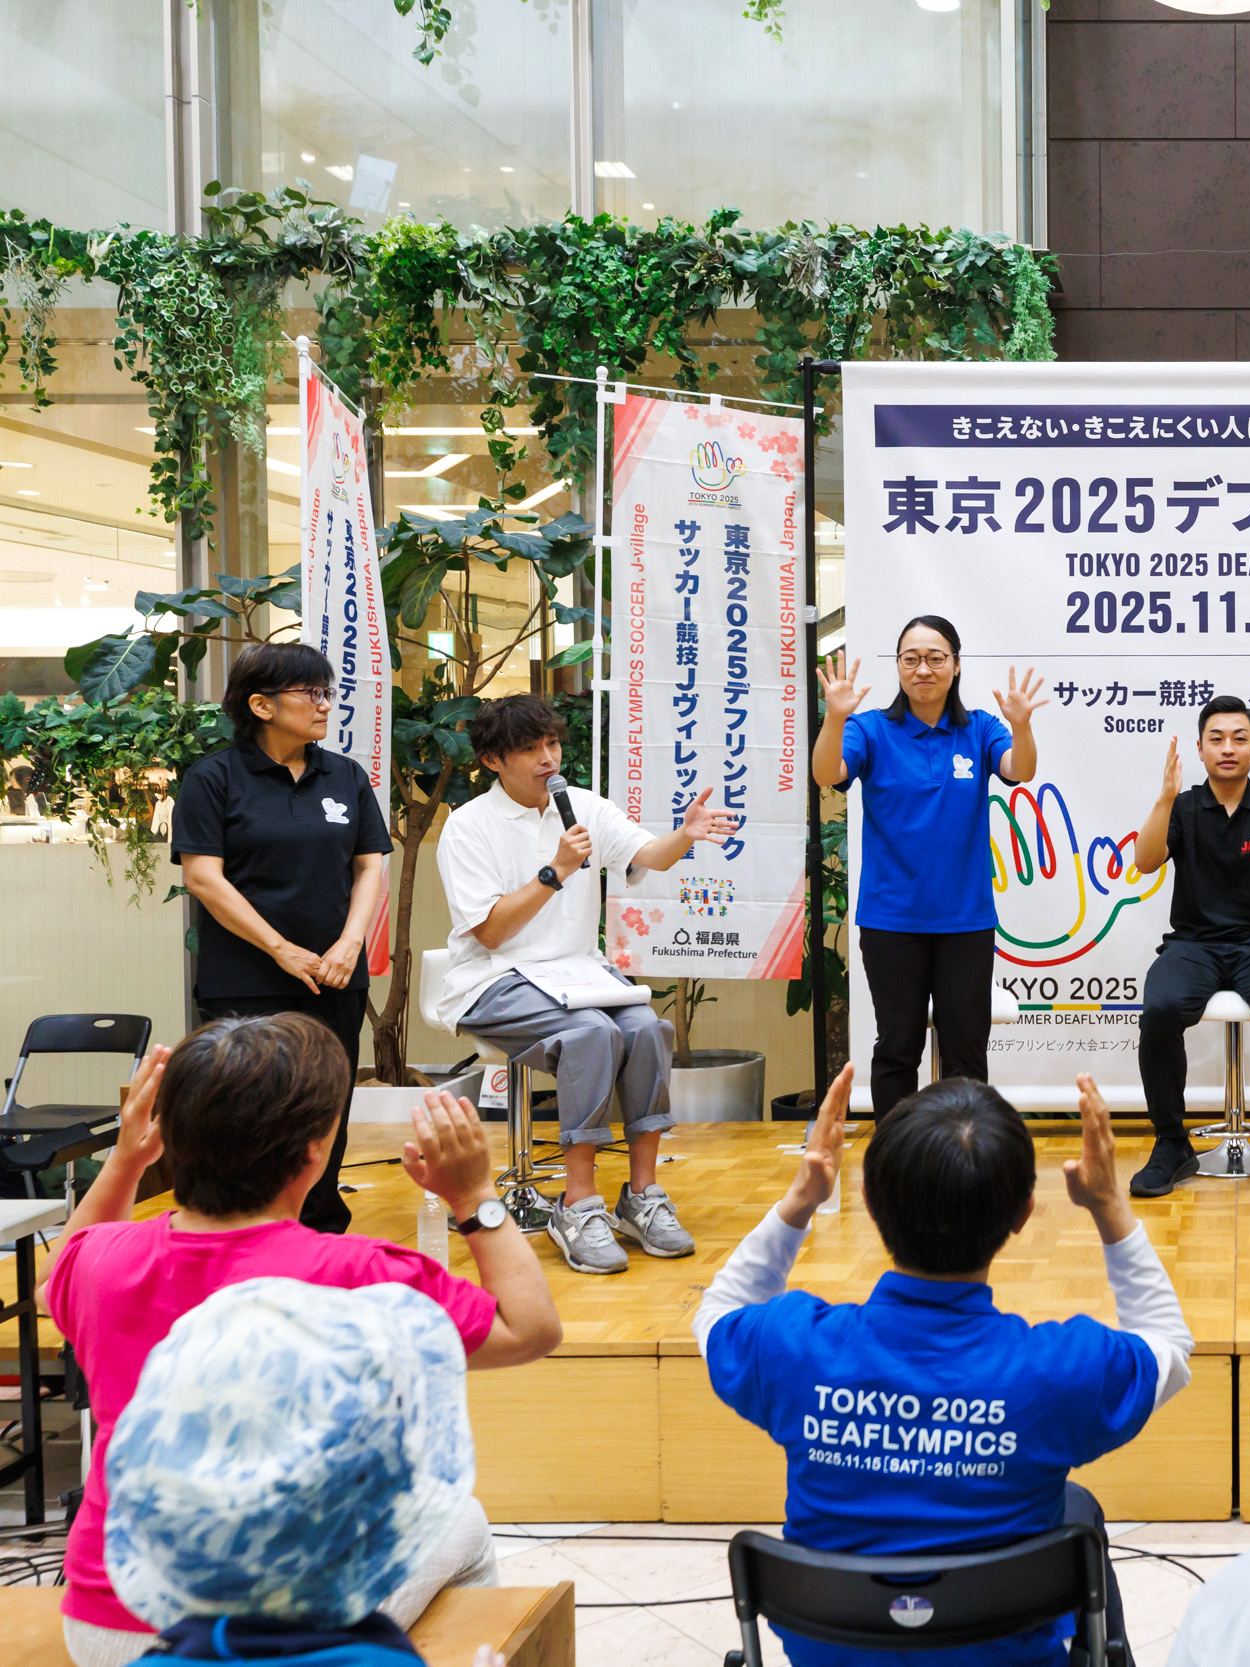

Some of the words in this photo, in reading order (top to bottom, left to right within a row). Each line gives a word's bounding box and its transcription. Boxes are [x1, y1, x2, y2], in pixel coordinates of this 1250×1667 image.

[689, 492, 717, 501] TOKYO
[720, 495, 739, 503] 2025
[357, 492, 370, 552] Japan.
[630, 503, 649, 572] J-village
[780, 490, 798, 551] Japan.
[1066, 553, 1140, 577] TOKYO
[1149, 553, 1209, 577] 2025
[364, 558, 382, 676] FUKUSHIMA,
[631, 578, 648, 654] SOCCER,
[780, 557, 798, 678] FUKUSHIMA,
[375, 686, 382, 699] to
[782, 683, 796, 702] to
[1053, 679, 1214, 708] サッカー競技
[628, 658, 645, 781] DEAFLYMPICS
[1104, 714, 1165, 733] Soccer
[370, 705, 382, 788] Welcome
[778, 707, 796, 792] Welcome
[627, 786, 642, 823] 2025
[652, 946, 704, 958] Fukushima
[708, 948, 758, 959] Prefecture
[696, 931, 739, 946] 福島県
[1000, 977, 1059, 1001] KYO
[1070, 977, 1138, 1001] 2025
[815, 1385, 920, 1420] TOKYO
[932, 1397, 1006, 1425] 2025
[803, 1414, 1018, 1456] DEAFLYMPICS
